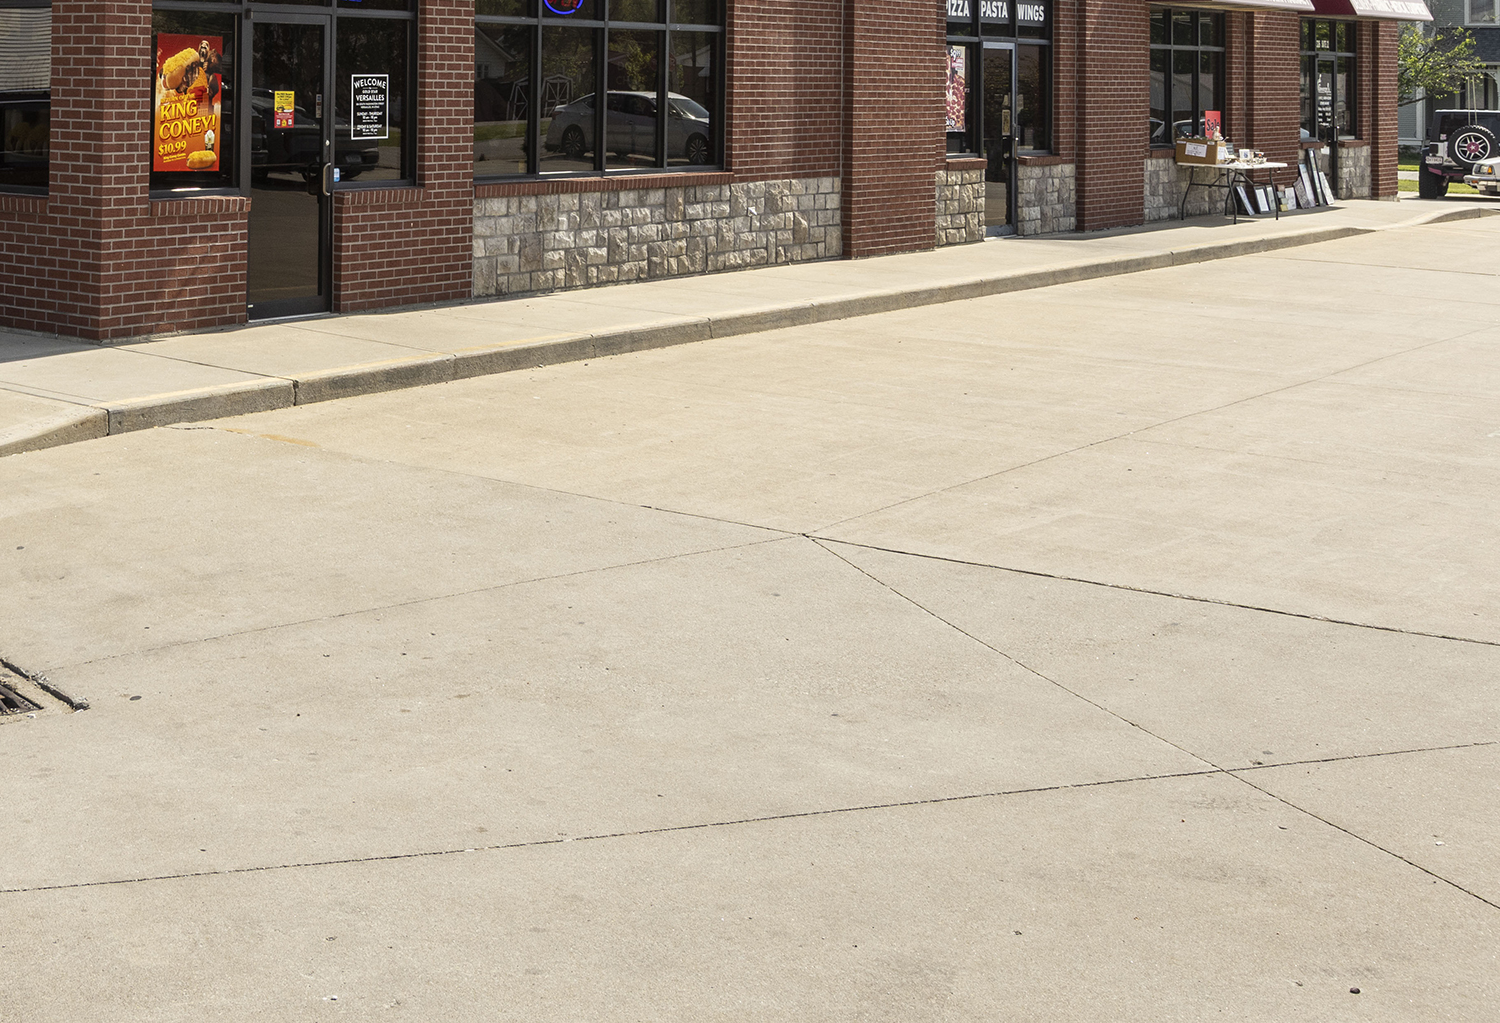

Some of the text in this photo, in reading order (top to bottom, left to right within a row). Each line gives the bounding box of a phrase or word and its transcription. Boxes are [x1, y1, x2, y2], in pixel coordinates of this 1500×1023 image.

[980, 0, 1008, 18] PASTA
[1017, 4, 1045, 22] WINGS
[354, 78, 386, 89] WELCOME
[356, 94, 385, 102] VERSAILLES
[160, 99, 198, 121] KING
[159, 114, 217, 140] CONEY!
[158, 140, 187, 156] $10.99
